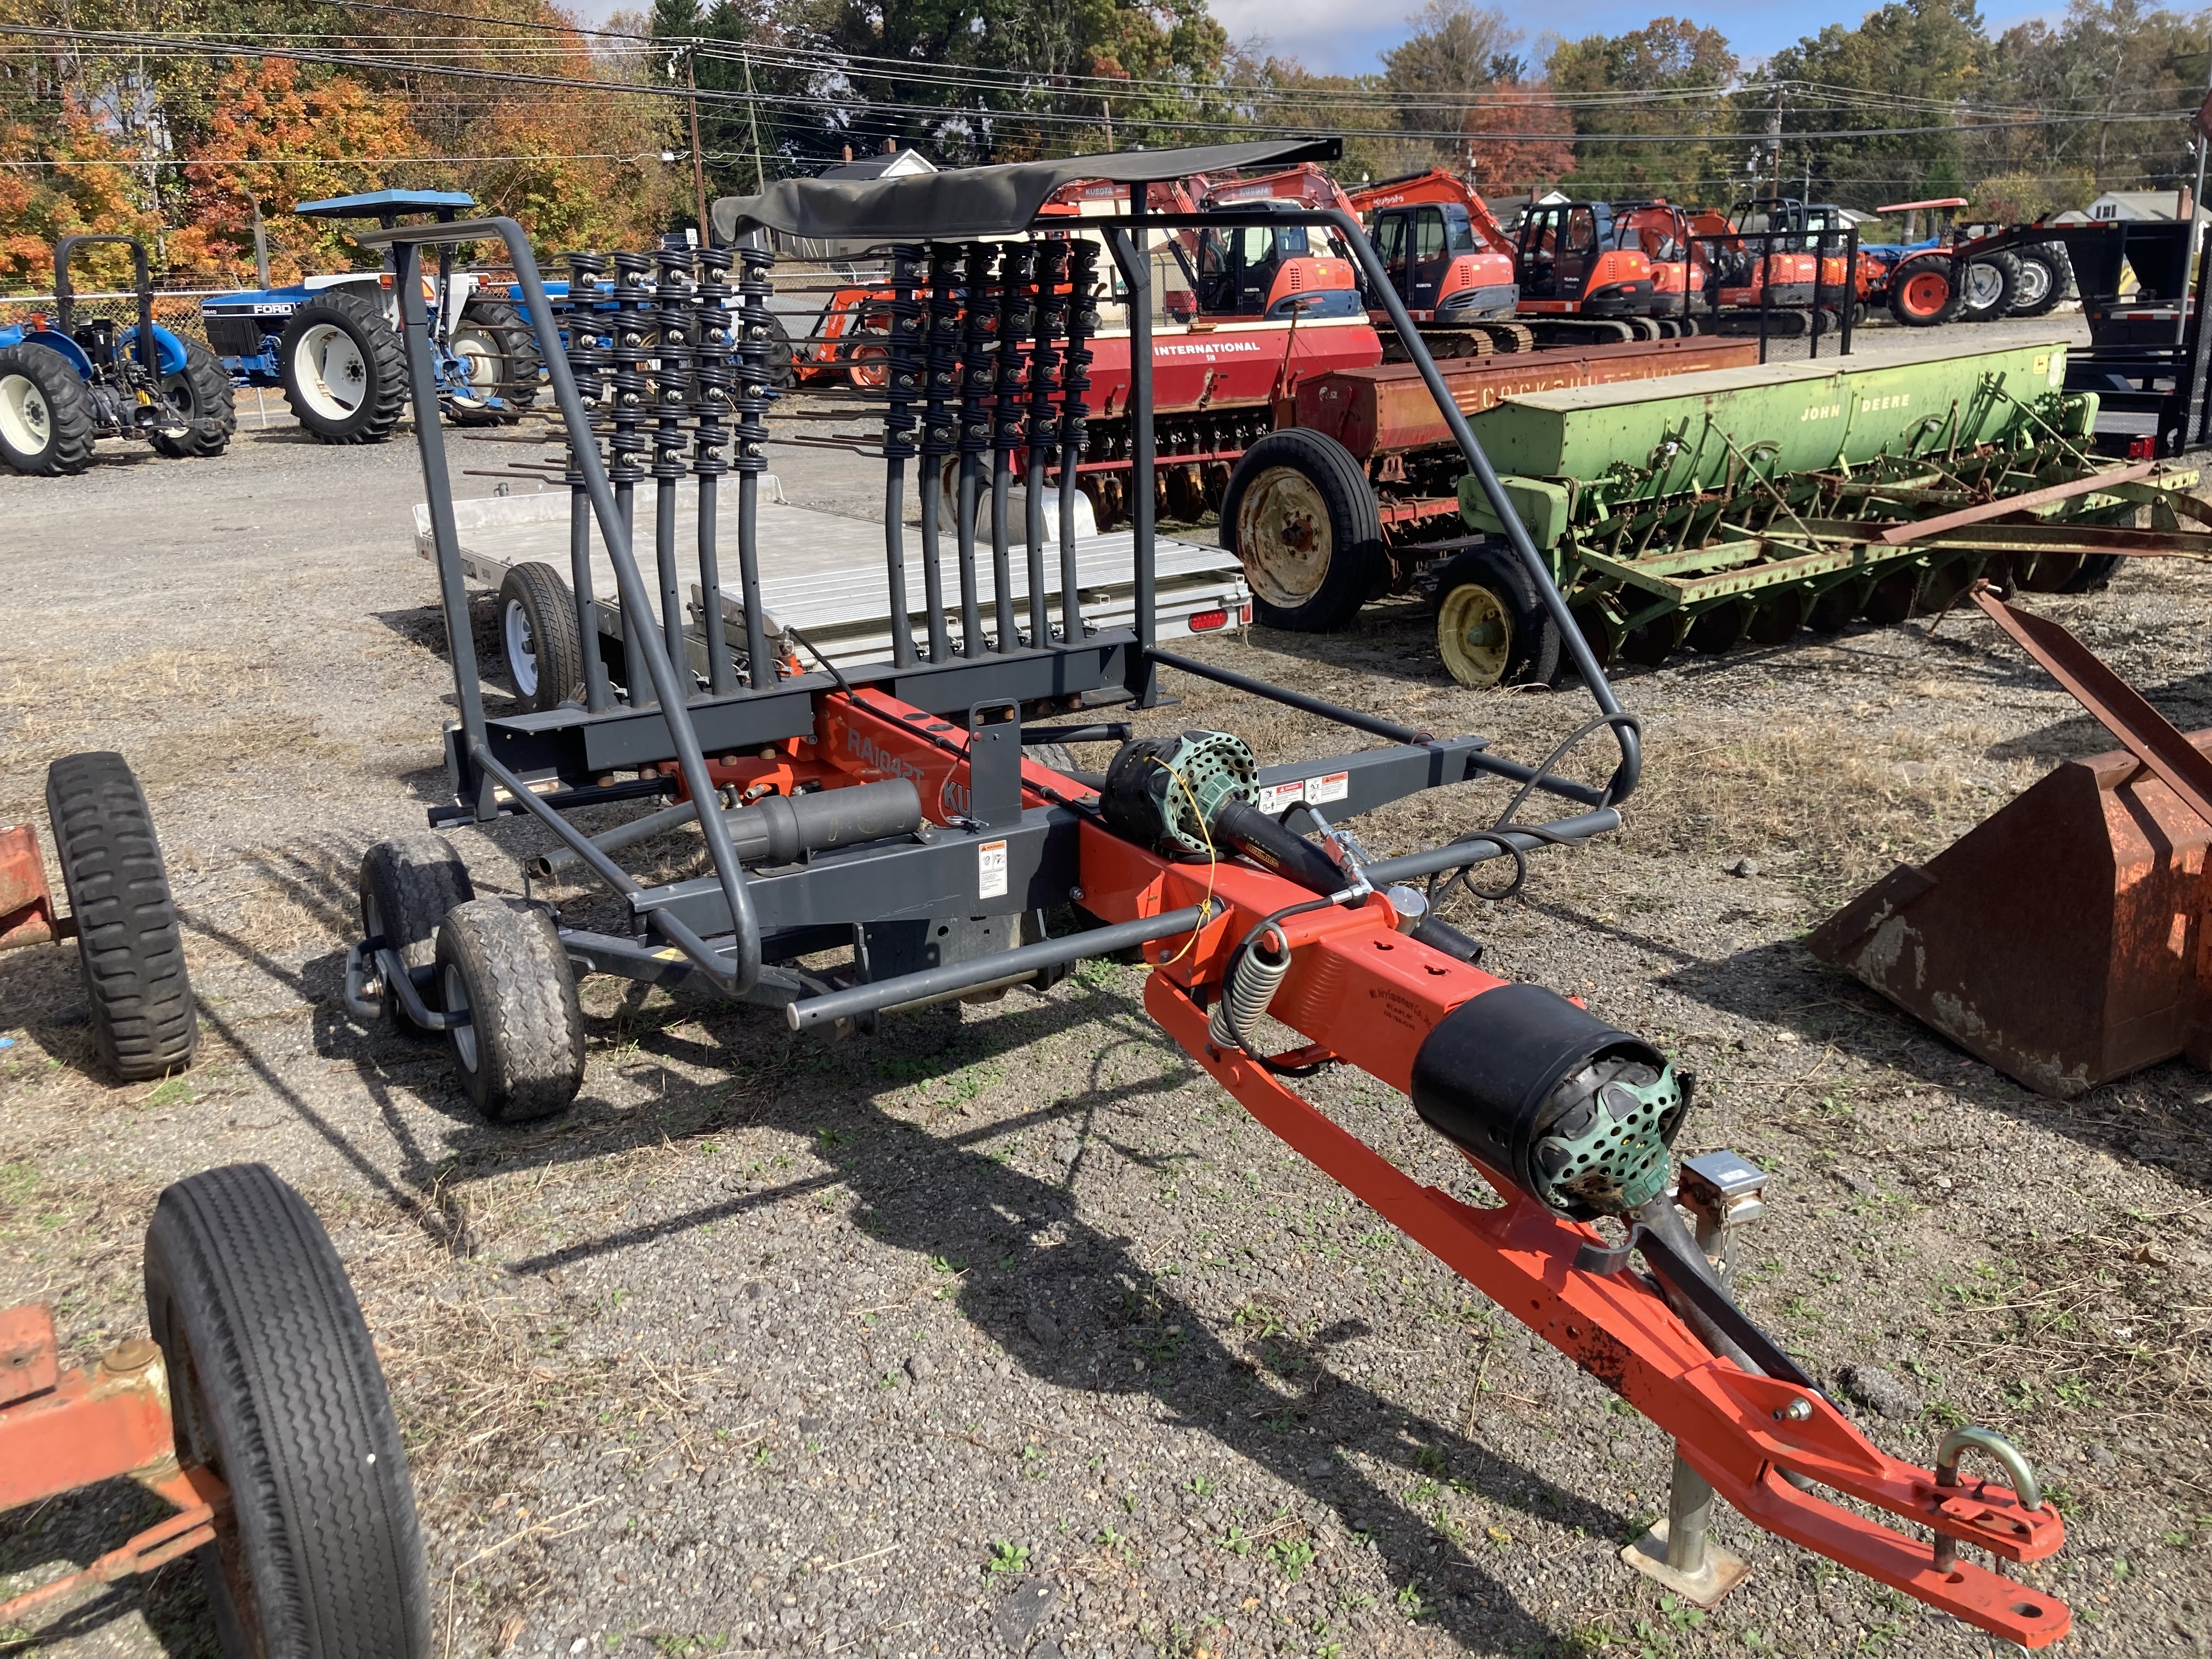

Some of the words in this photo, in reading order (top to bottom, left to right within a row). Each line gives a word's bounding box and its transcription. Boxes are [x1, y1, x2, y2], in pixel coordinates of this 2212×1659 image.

[1086, 187, 1113, 195] KUBOTA
[1373, 194, 1404, 206] Kubota
[253, 304, 292, 314] FORD
[1154, 341, 1261, 356] INTERNATIONAL
[1801, 404, 1841, 422] JOHN
[1862, 393, 1910, 413] DEERE
[943, 777, 973, 818] KU
